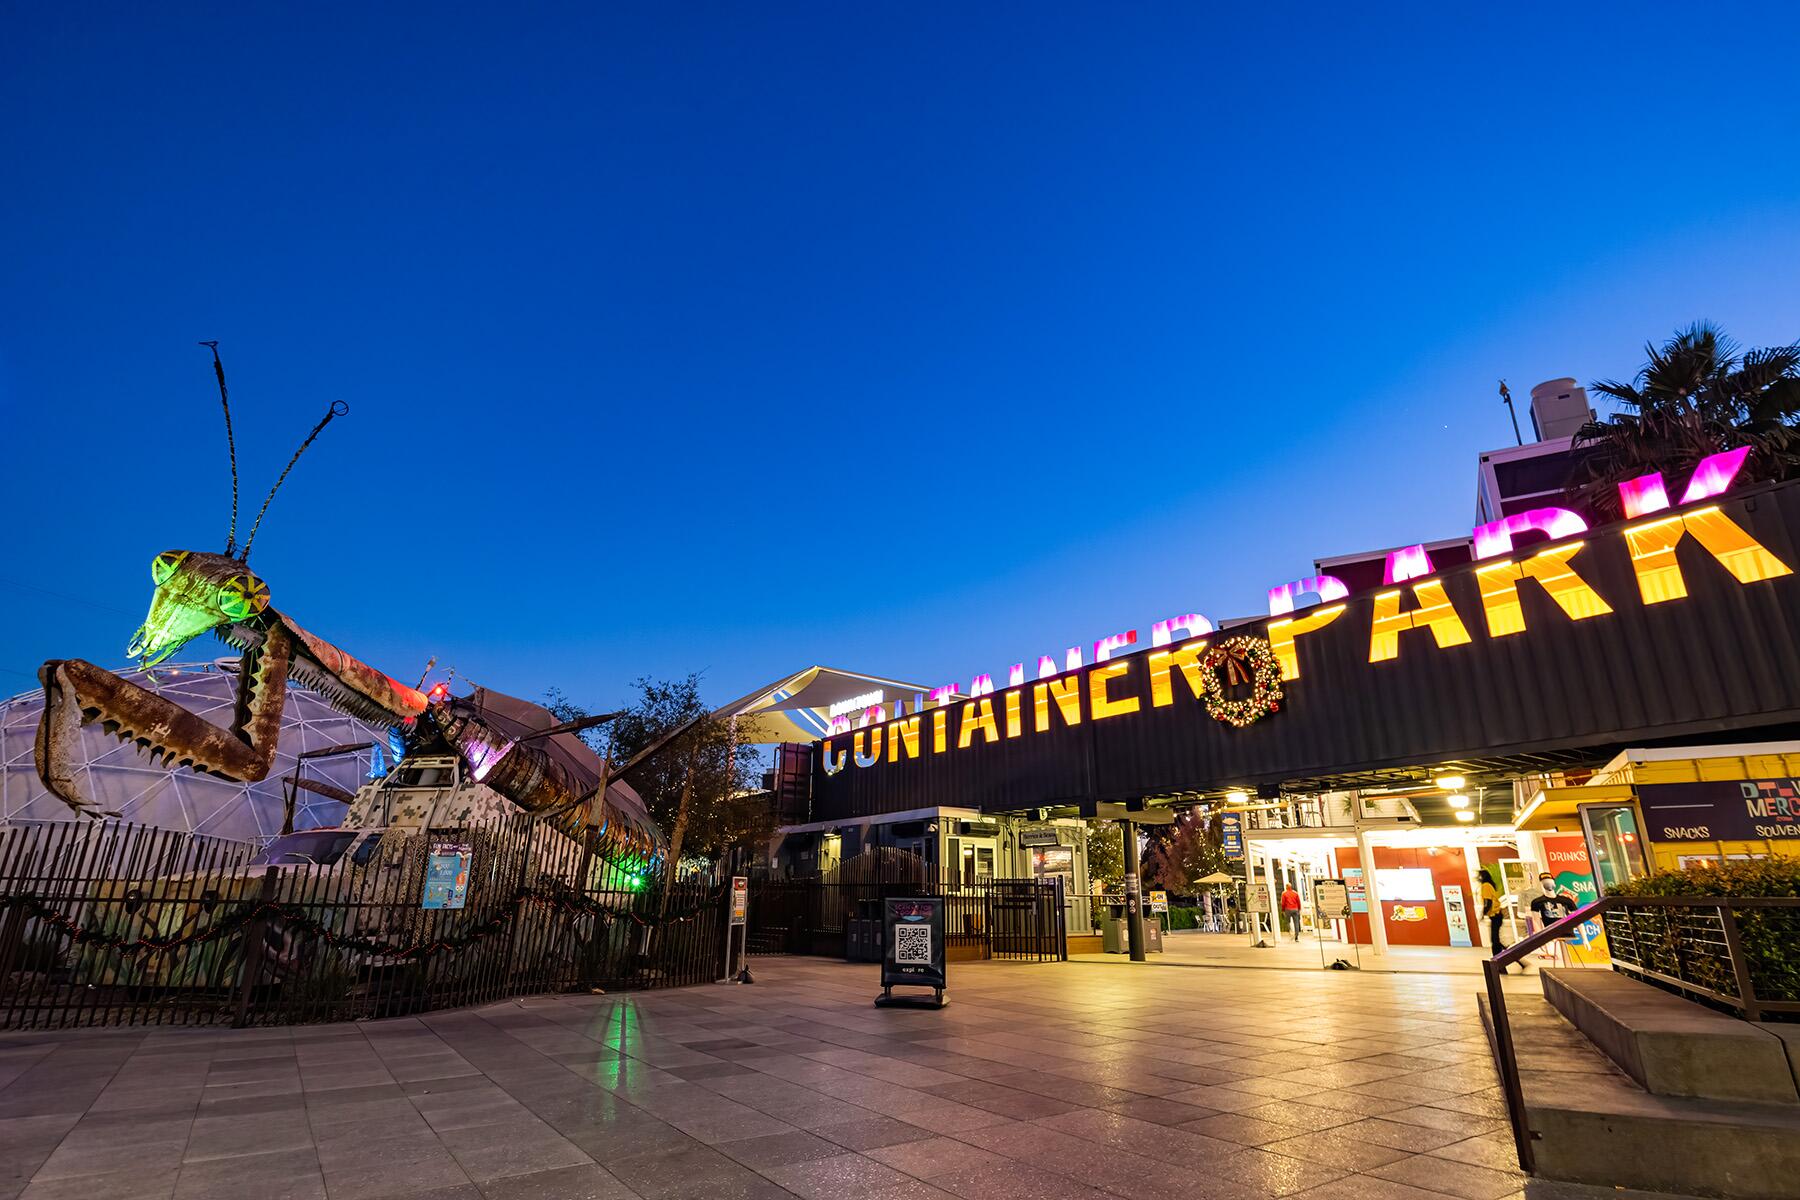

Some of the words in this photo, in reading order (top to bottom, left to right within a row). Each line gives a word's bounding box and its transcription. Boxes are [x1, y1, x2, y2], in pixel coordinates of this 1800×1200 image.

[822, 613, 1213, 776] CONTAINER
[1267, 445, 1794, 681] PARK
[1663, 826, 1710, 839] SNACKS
[1549, 851, 1587, 862] DRINKS
